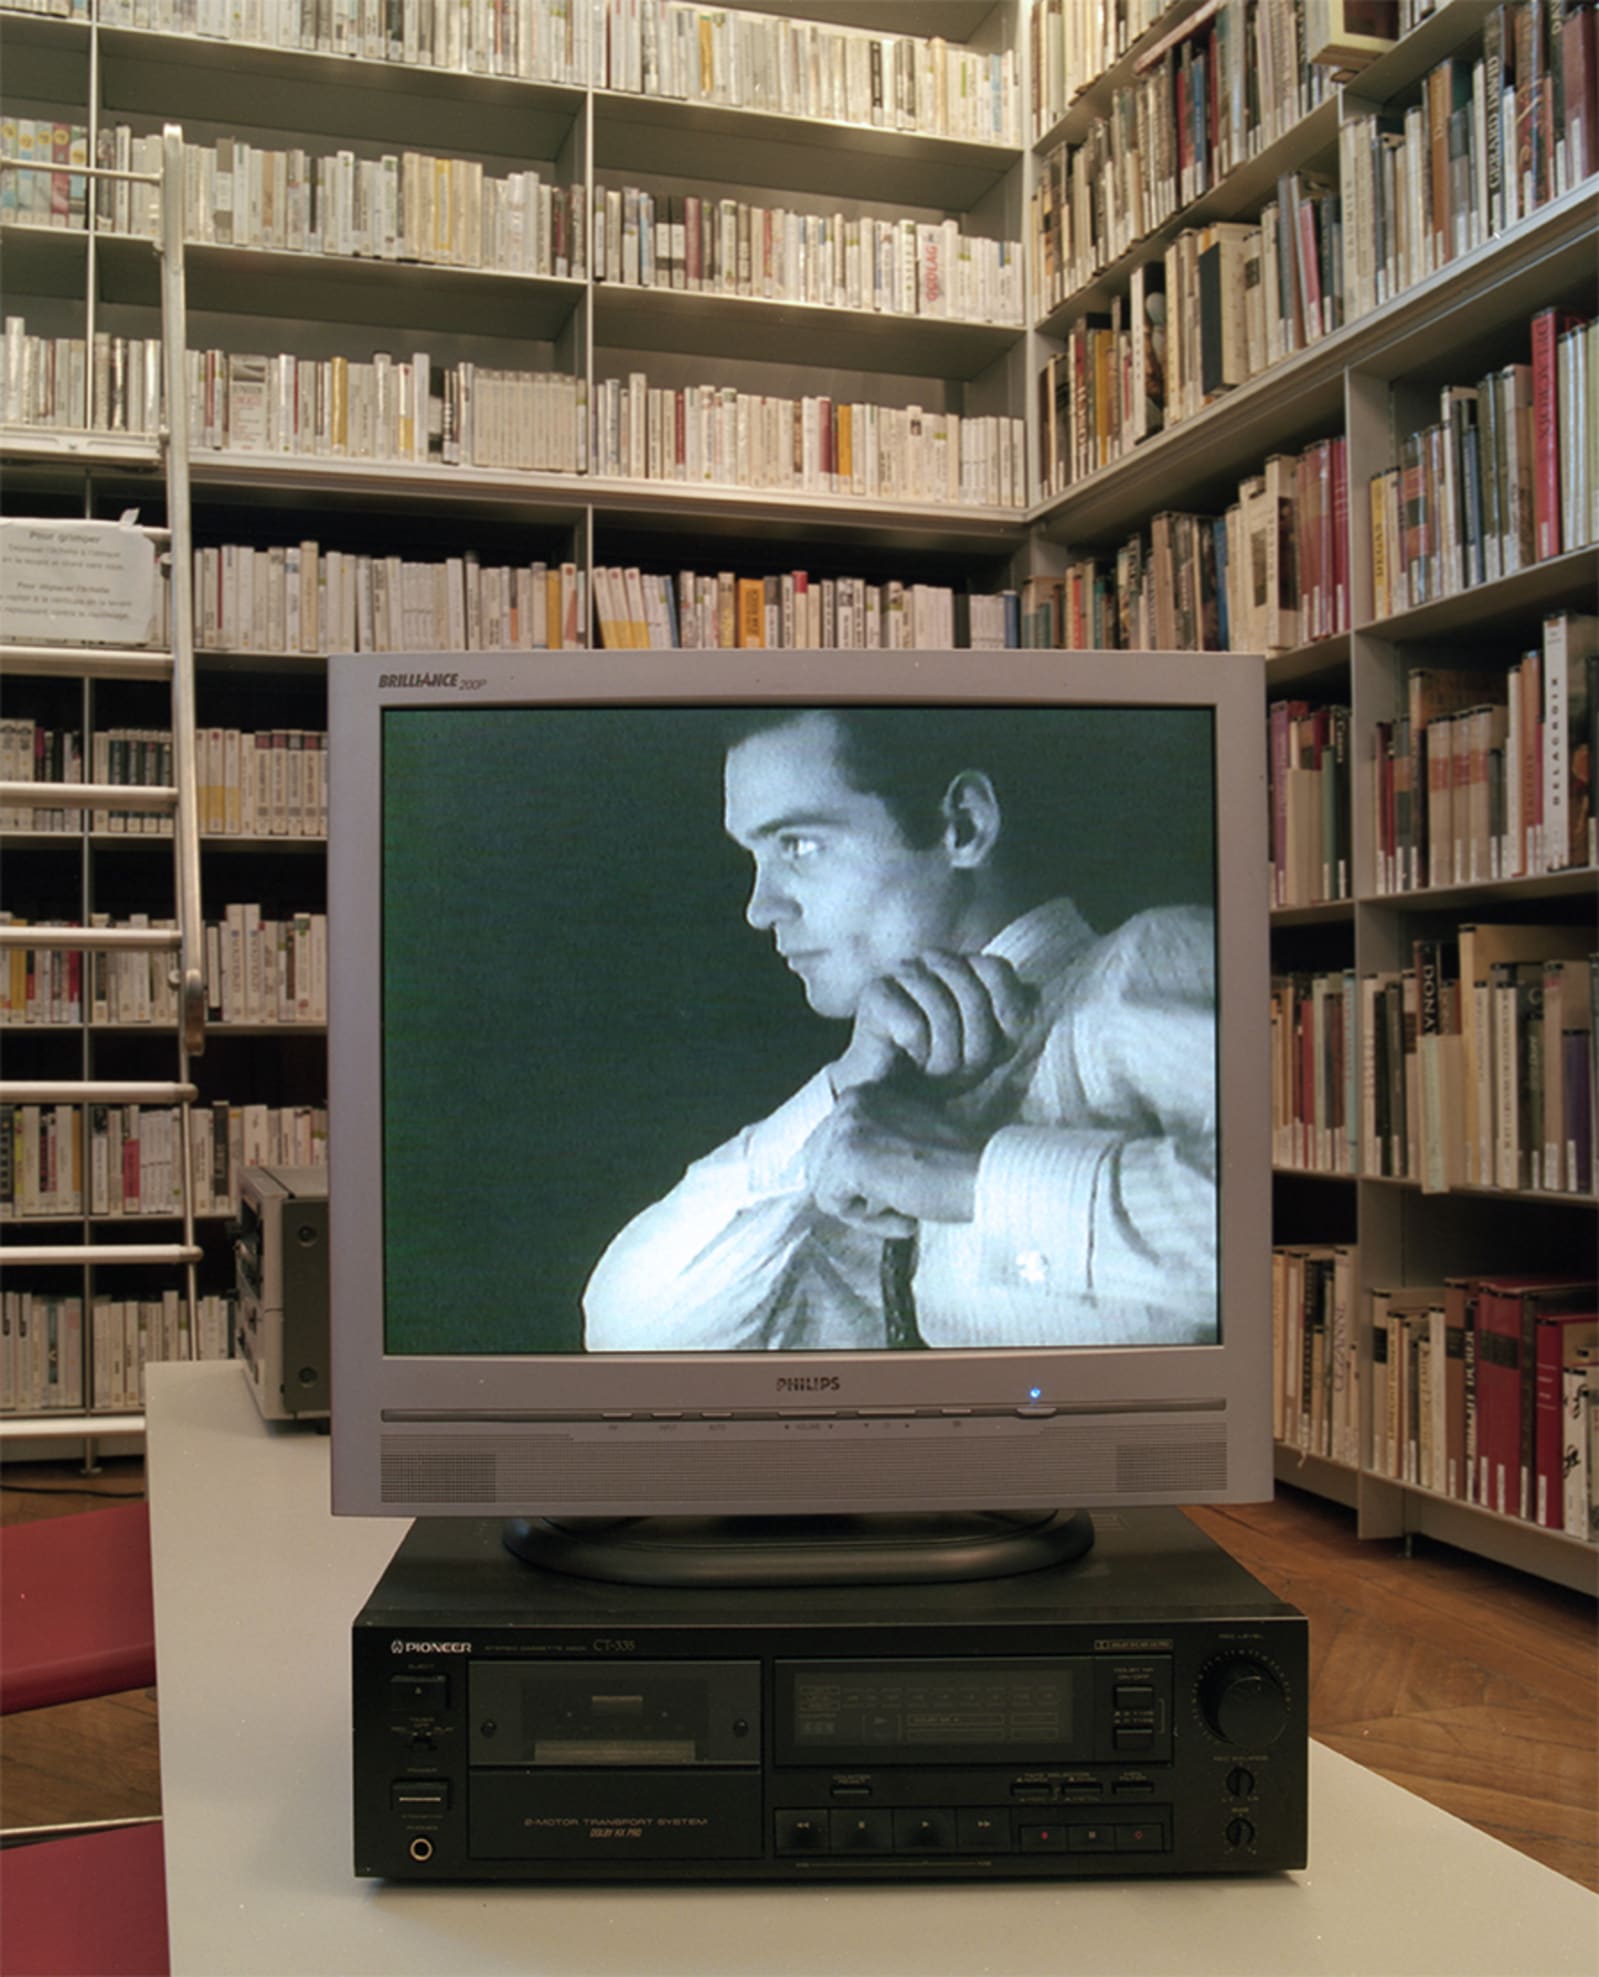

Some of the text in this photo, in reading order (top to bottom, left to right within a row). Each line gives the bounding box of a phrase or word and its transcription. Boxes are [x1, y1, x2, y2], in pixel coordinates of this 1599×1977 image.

[378, 672, 459, 688] BRILLIANCE
[776, 1377, 841, 1392] PHILIPS
[405, 1641, 472, 1653] PIONEER
